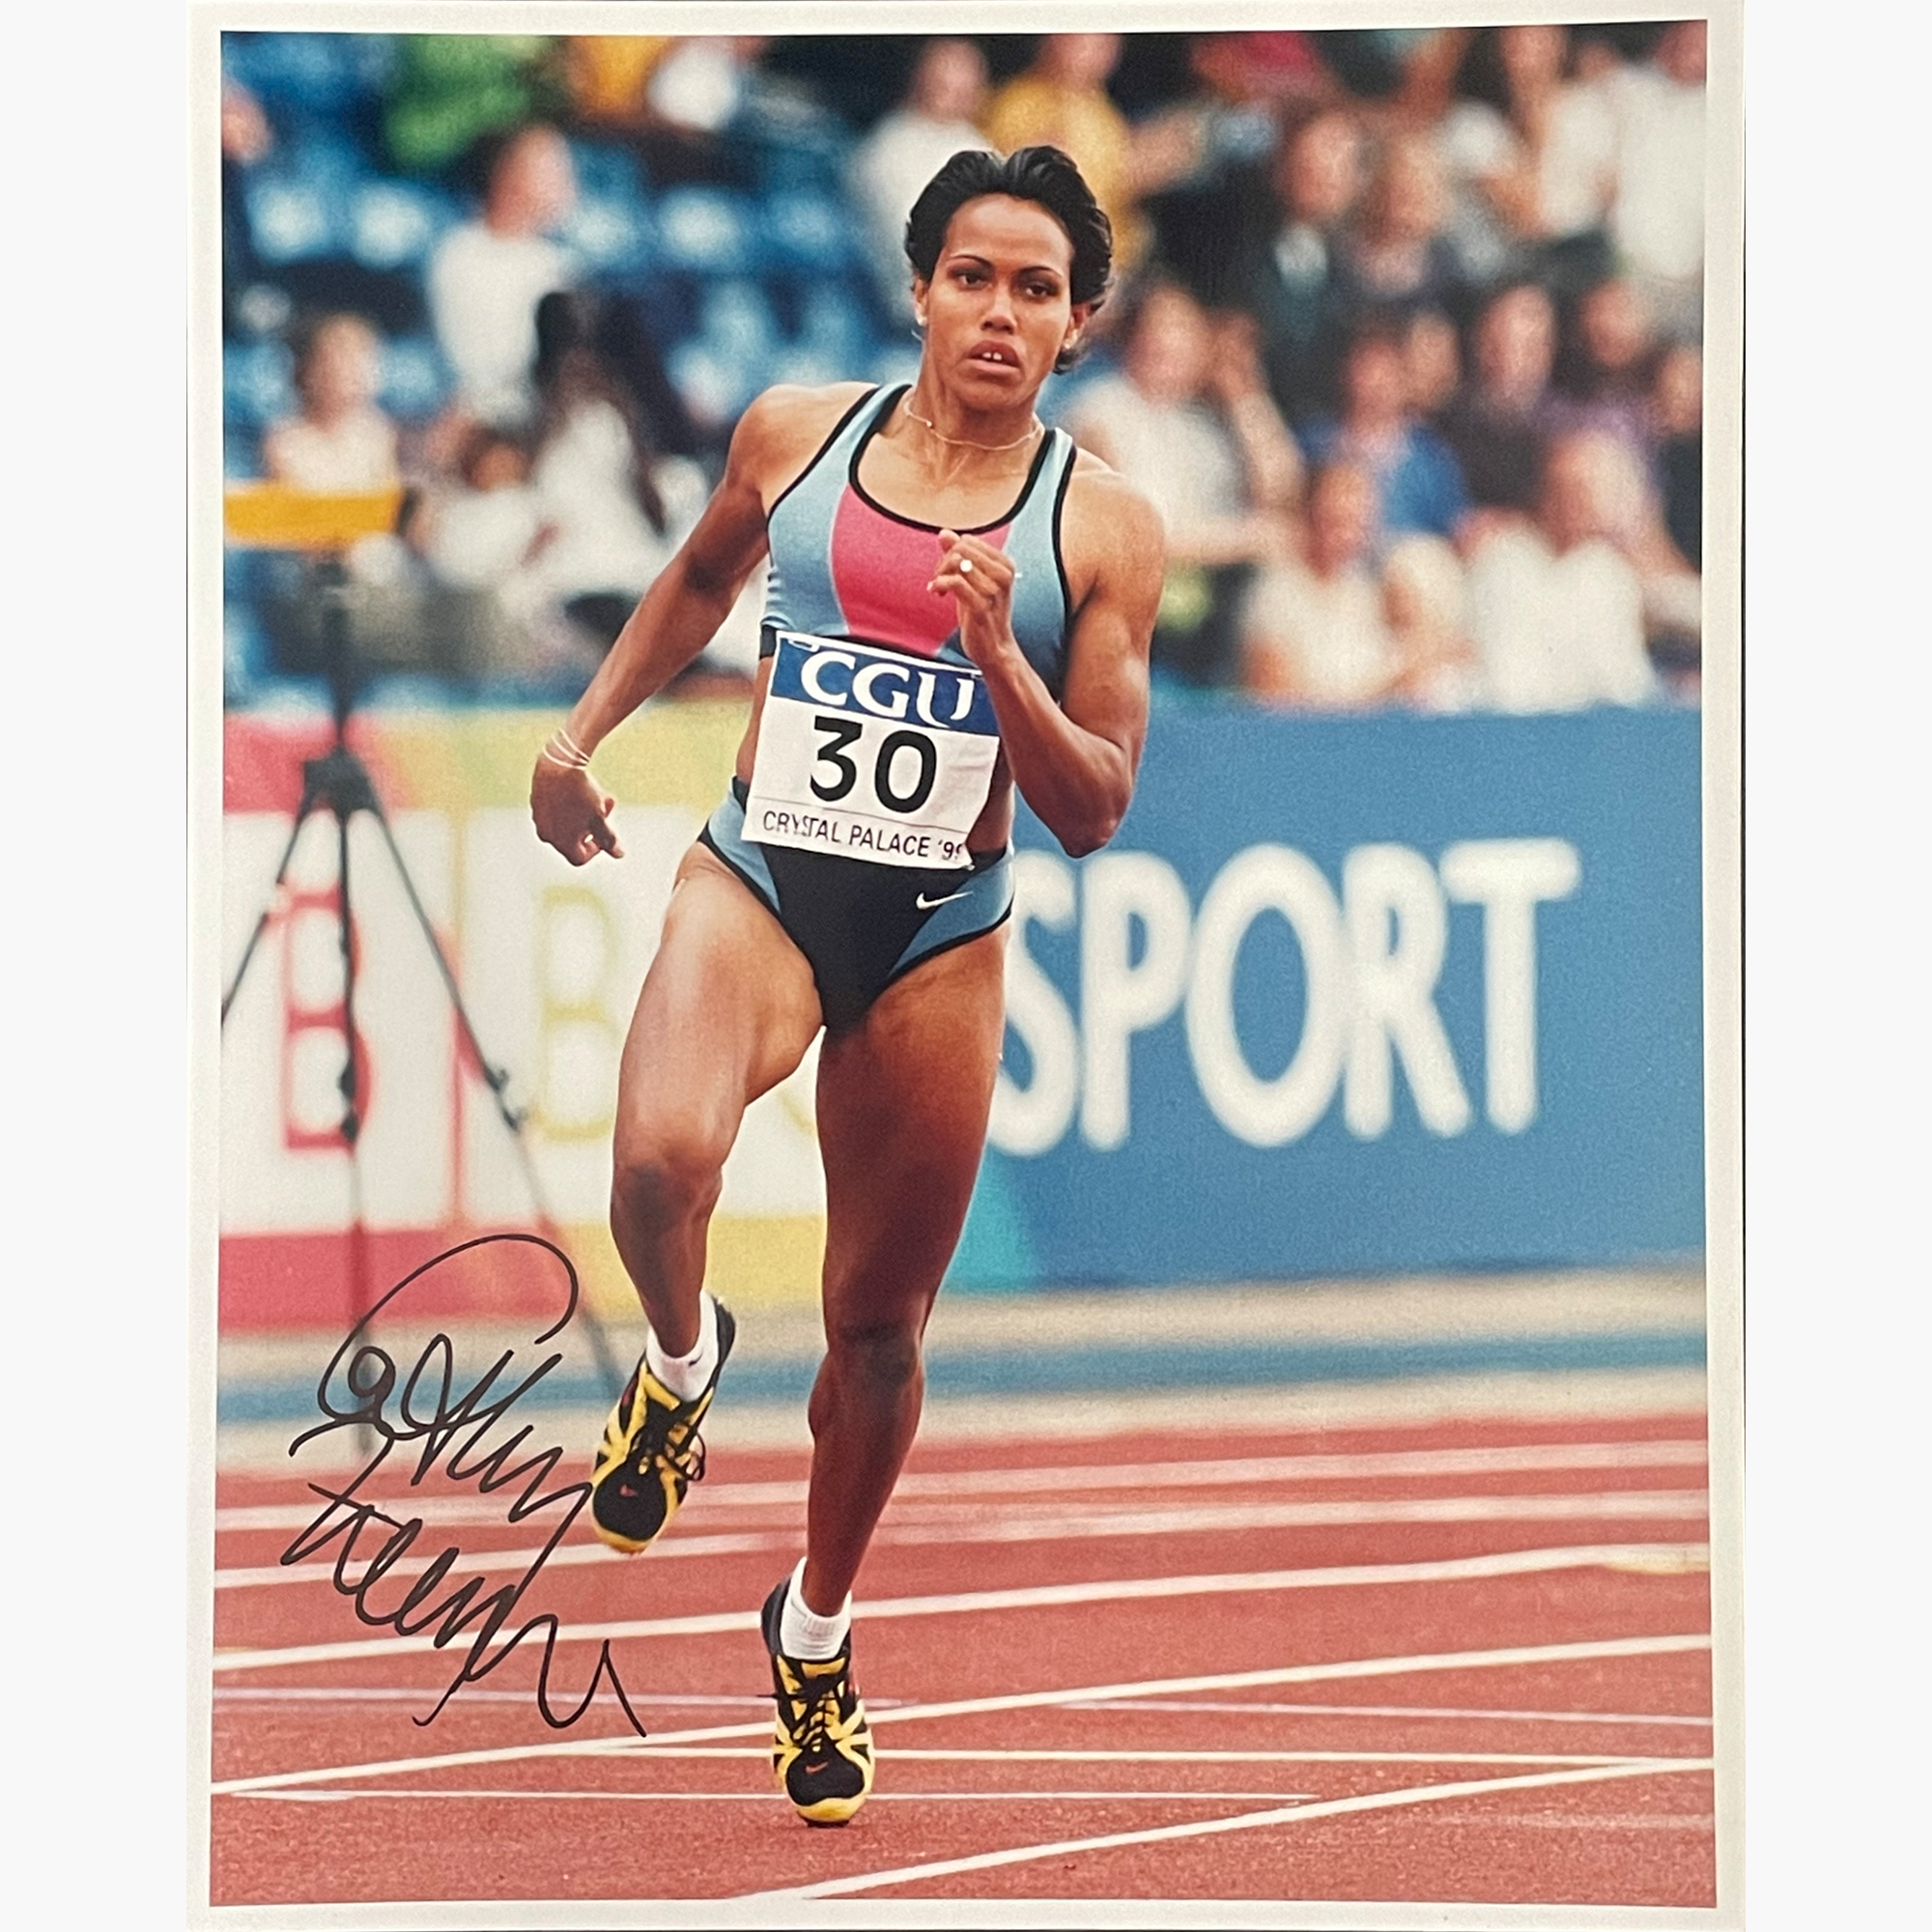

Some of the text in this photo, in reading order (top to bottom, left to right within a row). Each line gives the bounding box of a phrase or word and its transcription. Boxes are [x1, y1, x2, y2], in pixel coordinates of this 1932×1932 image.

[801, 650, 975, 728] CGU
[810, 715, 937, 813] 30
[763, 810, 840, 844] CRYSTAL
[849, 825, 931, 858] PALACE
[987, 837, 1582, 1156] SPORT
